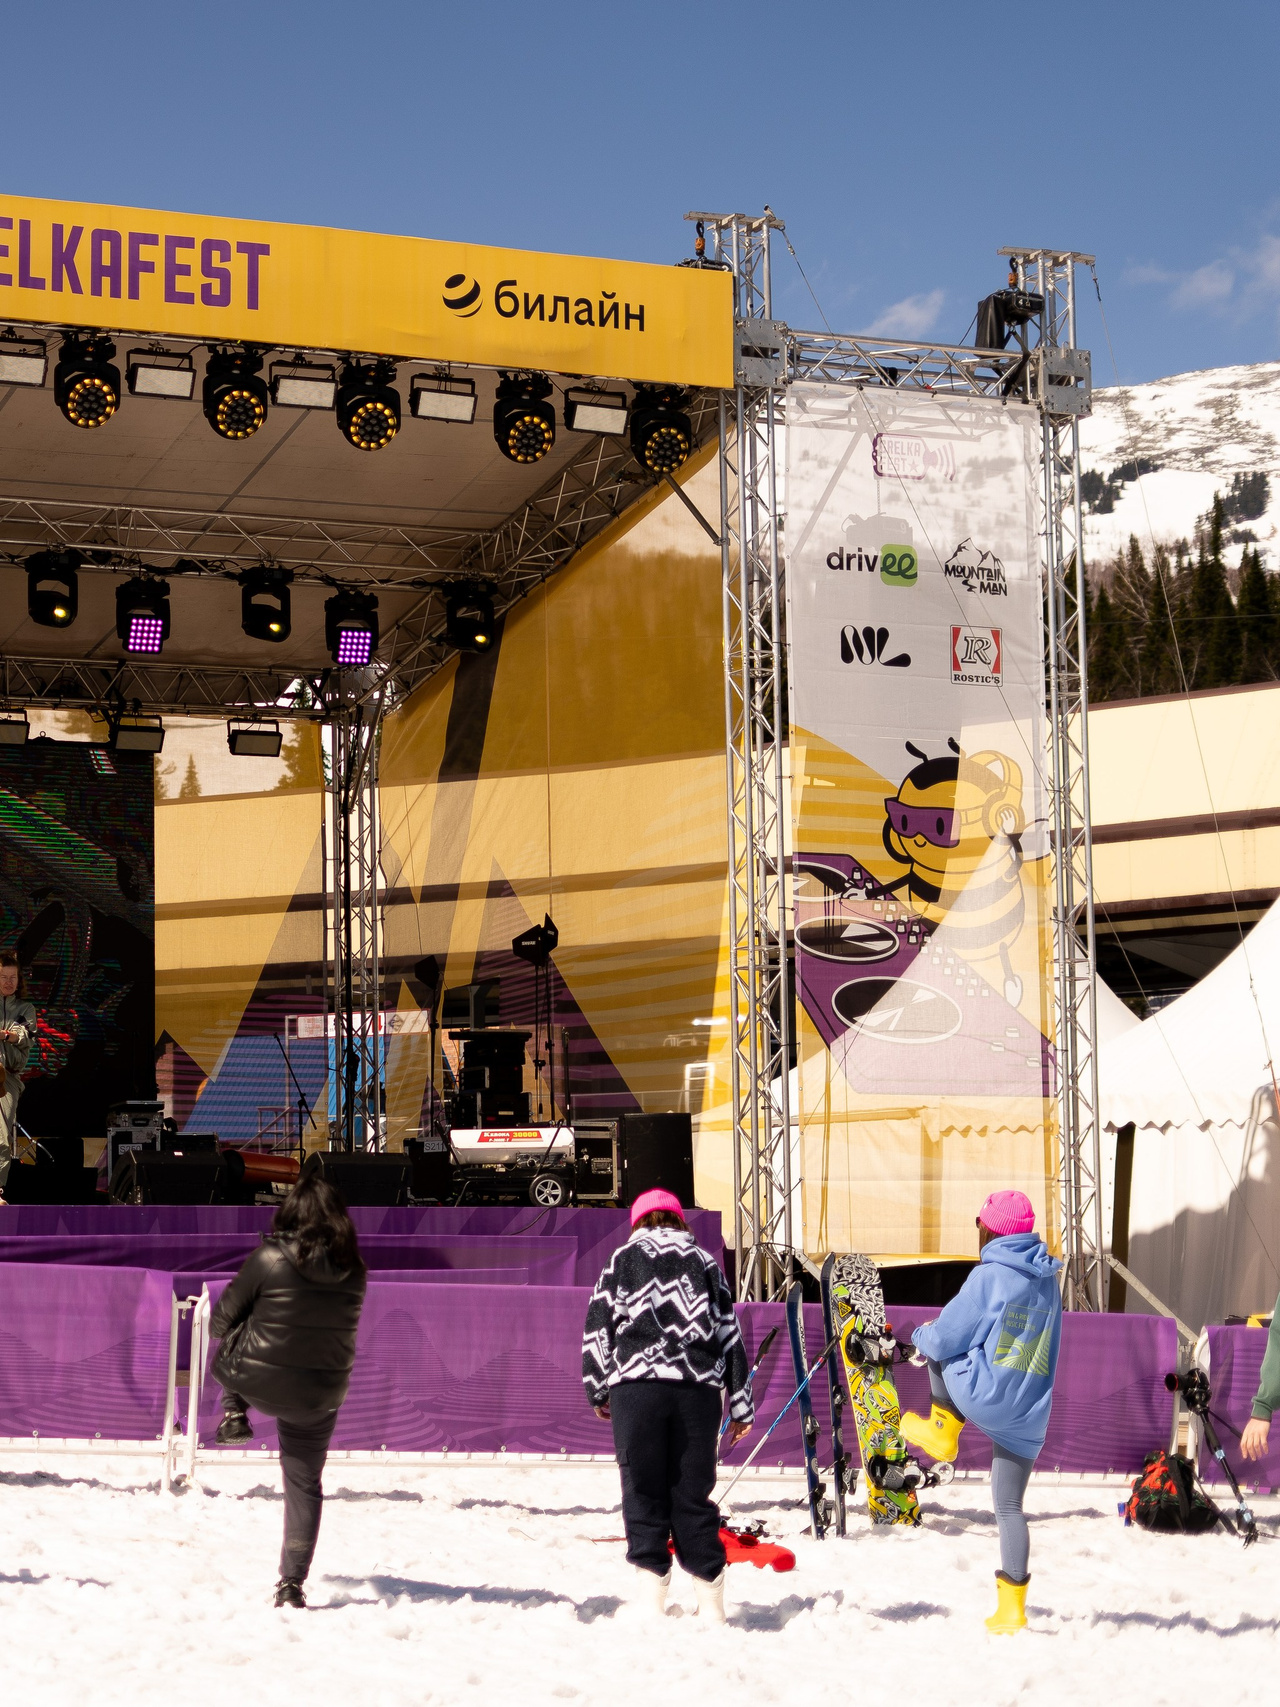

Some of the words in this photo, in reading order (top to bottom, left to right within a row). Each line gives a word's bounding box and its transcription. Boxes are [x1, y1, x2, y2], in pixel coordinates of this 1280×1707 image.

[494, 279, 646, 332] билайн
[826, 546, 918, 580] drivee
[979, 581, 1008, 597] MAN
[953, 673, 1001, 684] ROSTIC'S
